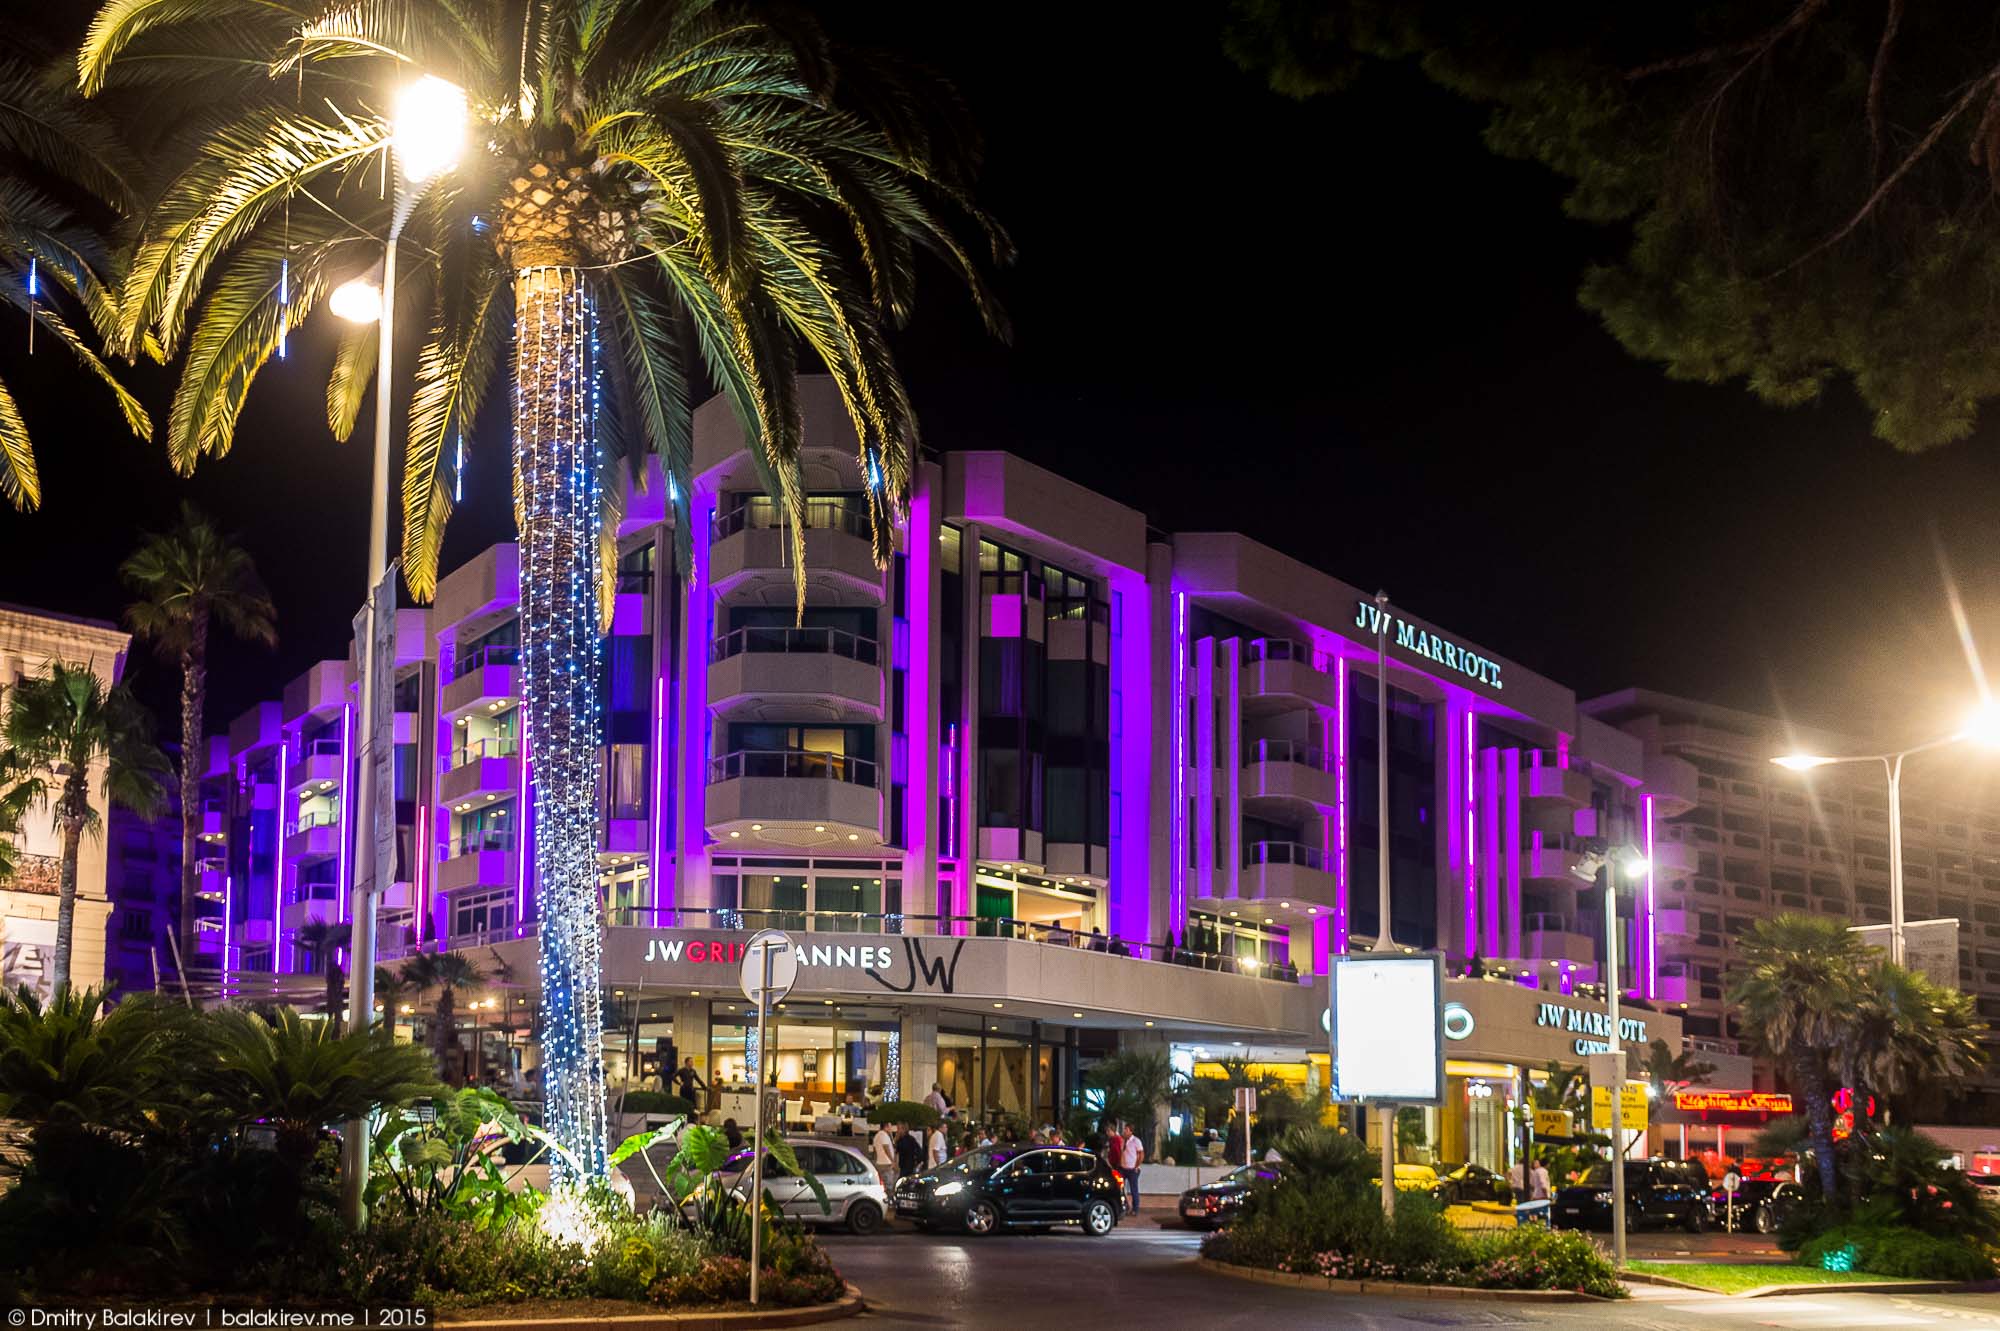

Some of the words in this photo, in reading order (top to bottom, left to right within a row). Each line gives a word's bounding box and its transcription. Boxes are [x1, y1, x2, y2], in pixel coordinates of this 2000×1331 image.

[1356, 602, 1391, 634] JW
[794, 945, 892, 969] ANNES
[864, 937, 965, 993] JW
[1538, 1003, 1565, 1028] JW
[1567, 1008, 1648, 1043] MARROTT
